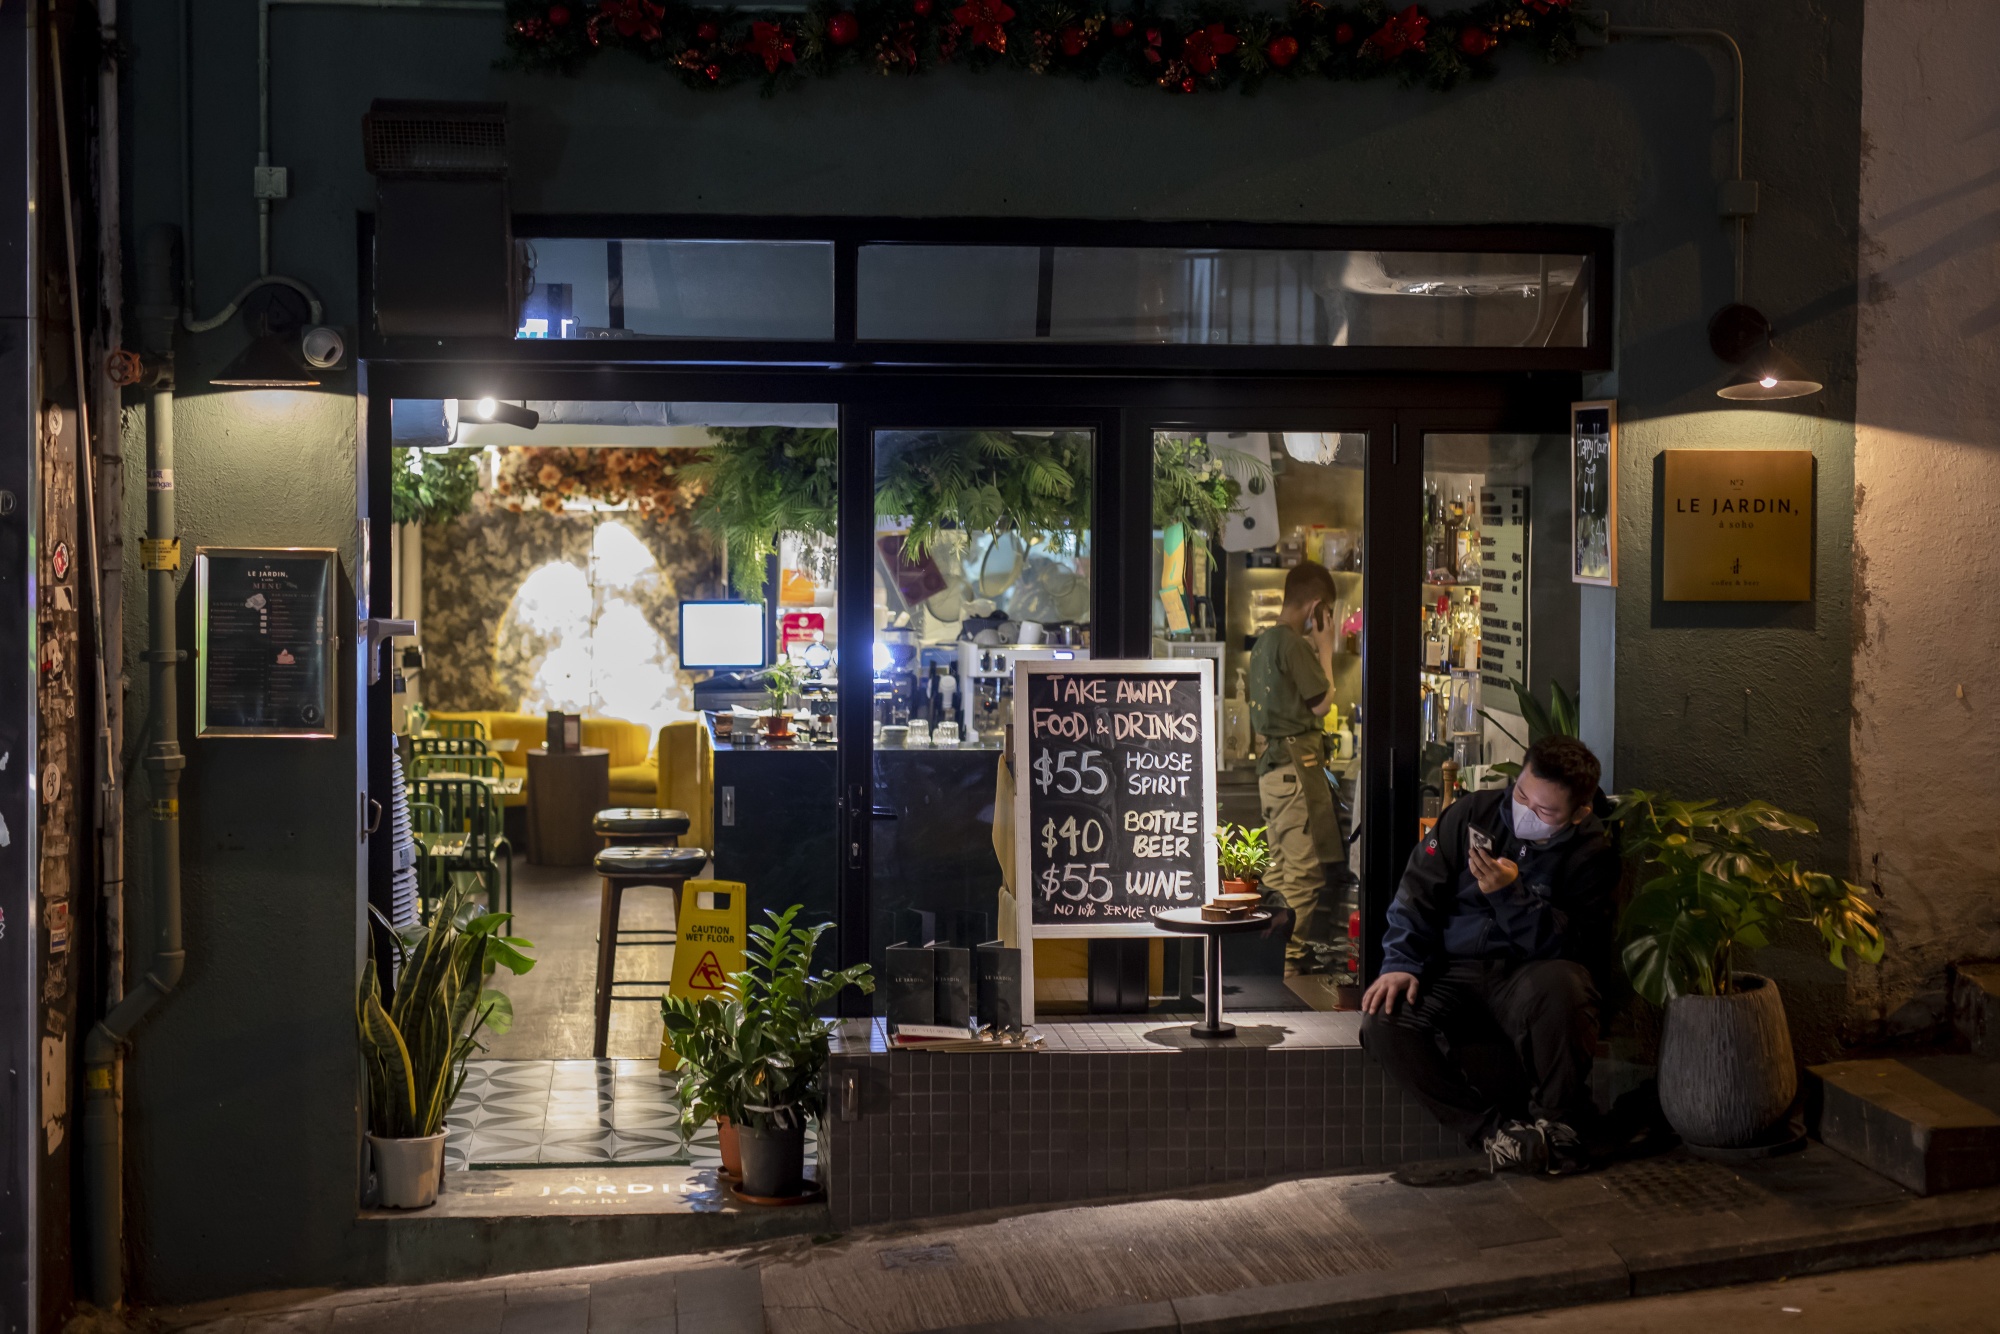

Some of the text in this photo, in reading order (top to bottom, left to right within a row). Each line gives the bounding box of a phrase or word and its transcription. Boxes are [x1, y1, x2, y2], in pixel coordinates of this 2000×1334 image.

[1677, 498, 1799, 516] LE JARDIN,
[1729, 520, 1754, 529] soho
[1046, 675, 1177, 705] TAKE AWAY
[1032, 708, 1198, 743] FOOD & DRINKS
[1033, 747, 1108, 795] $55
[1126, 752, 1192, 772] HOUSE
[1128, 774, 1190, 796] SPIRIT
[1124, 810, 1198, 834] BOTTLE
[1041, 816, 1103, 858] $40
[1133, 835, 1191, 858] BEER
[1041, 862, 1194, 903] $55 WINE
[1054, 904, 1074, 916] NO
[1078, 903, 1096, 917] 10%
[1103, 904, 1145, 919] SERVICE
[686, 933, 735, 943] WET FLOOR
[691, 925, 730, 935] CAUTION
